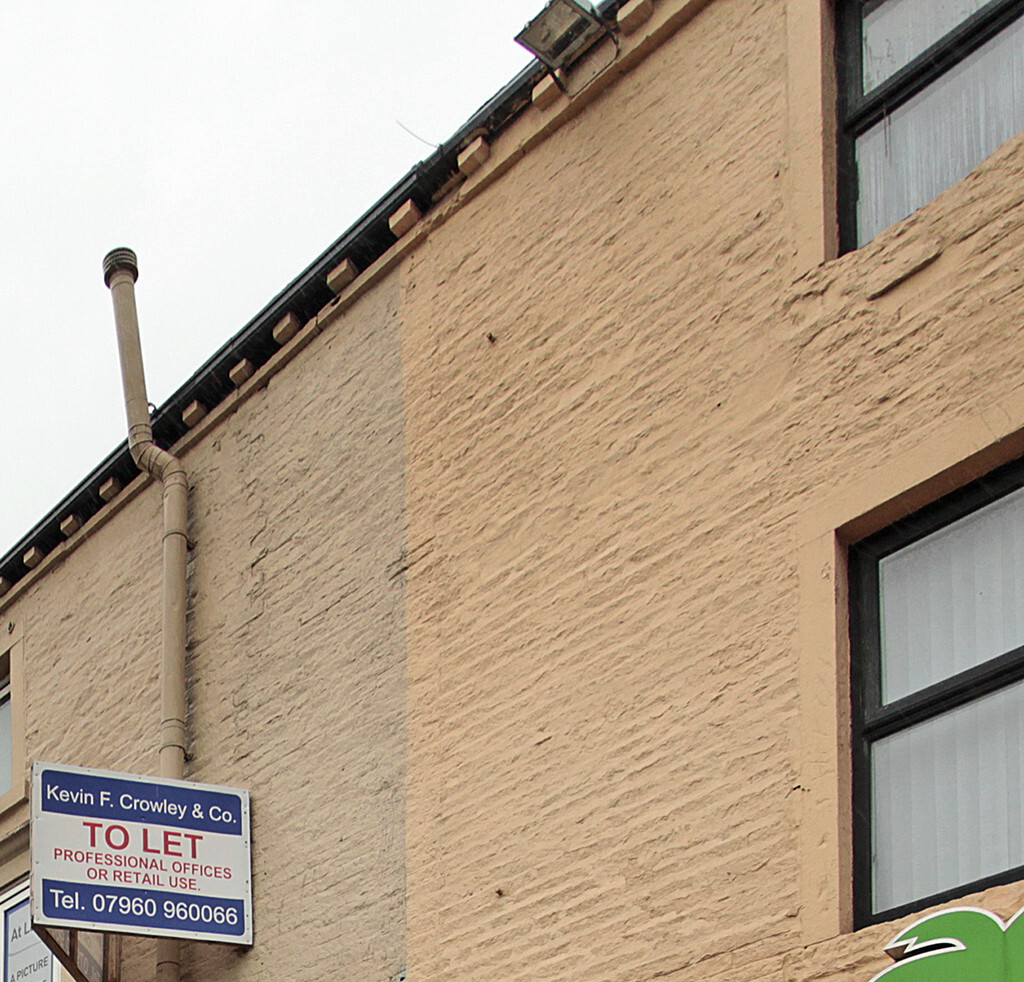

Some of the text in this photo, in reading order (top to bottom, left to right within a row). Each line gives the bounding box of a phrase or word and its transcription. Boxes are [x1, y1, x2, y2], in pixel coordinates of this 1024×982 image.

[46, 785, 236, 823] Kevin F. Crowley & Co.
[83, 822, 202, 858] TO LET
[54, 848, 231, 879] PROFESSIONAL OFFICES
[87, 868, 200, 891] OR RETAIL USE.
[50, 889, 237, 925] Tel. 07960 960066
[11, 927, 21, 942] At
[17, 956, 48, 979] PICTURE
